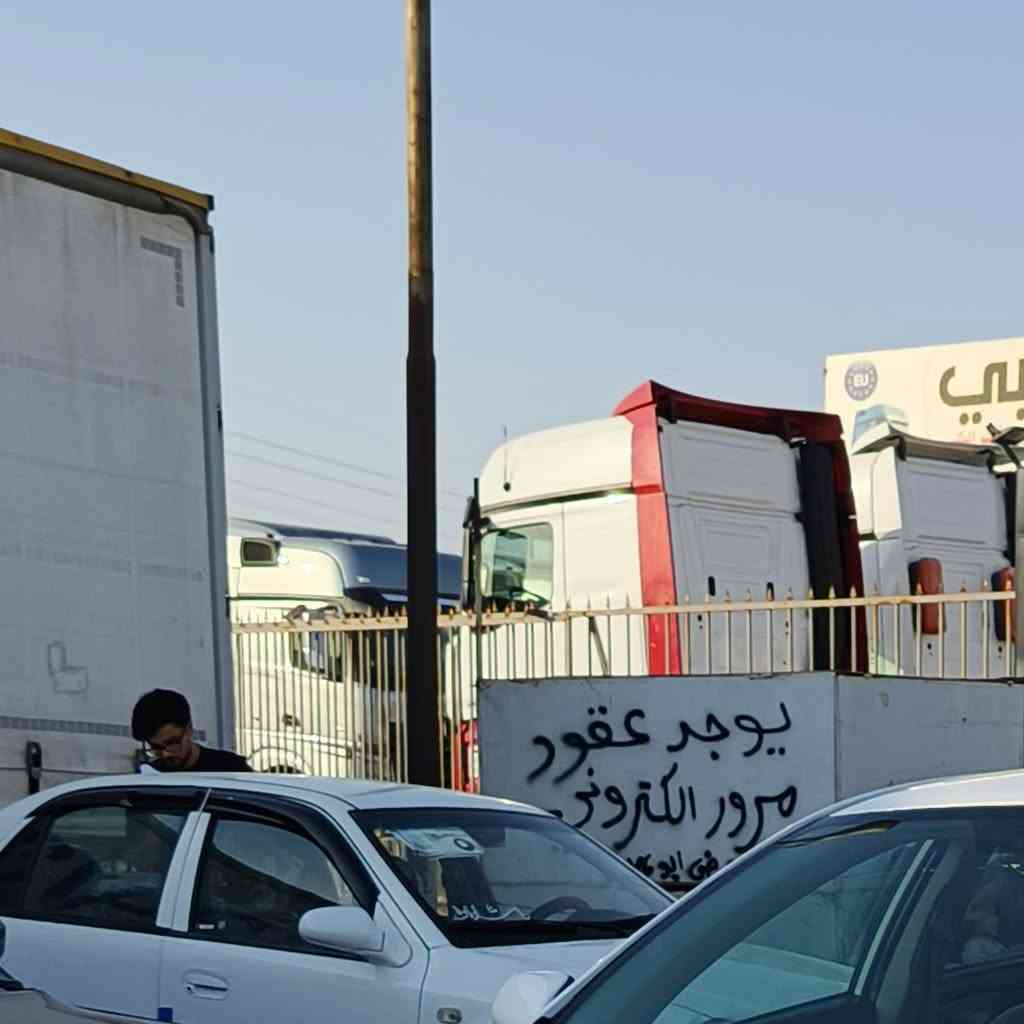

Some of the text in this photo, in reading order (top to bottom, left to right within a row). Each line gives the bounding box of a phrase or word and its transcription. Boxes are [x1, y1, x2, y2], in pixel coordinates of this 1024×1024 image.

[853, 373, 870, 387] EU
[666, 702, 792, 761] يوجد
[705, 784, 798, 853] مرور
